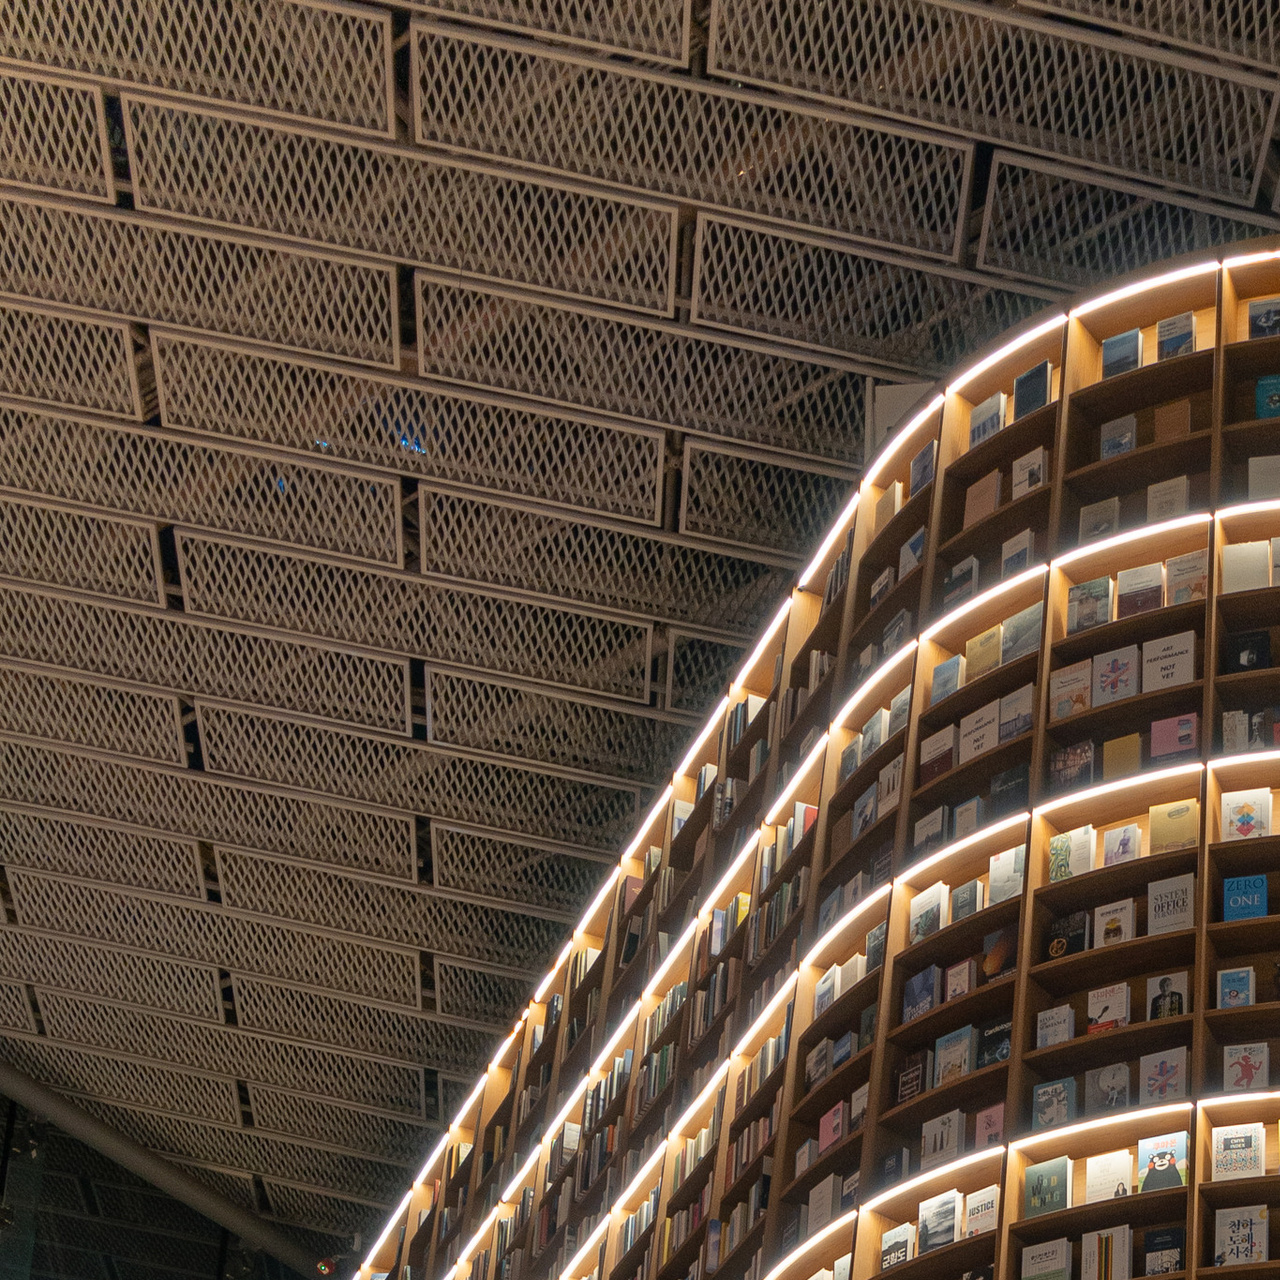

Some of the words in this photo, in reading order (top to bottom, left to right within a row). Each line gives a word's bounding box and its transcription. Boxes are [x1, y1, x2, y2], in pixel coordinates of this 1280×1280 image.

[1227, 878, 1265, 893] ZERO
[1153, 888, 1188, 903] SYSTEM
[1230, 893, 1262, 908] ONE
[1153, 897, 1189, 914] OFFICE
[968, 1199, 996, 1218] JUSTICE
